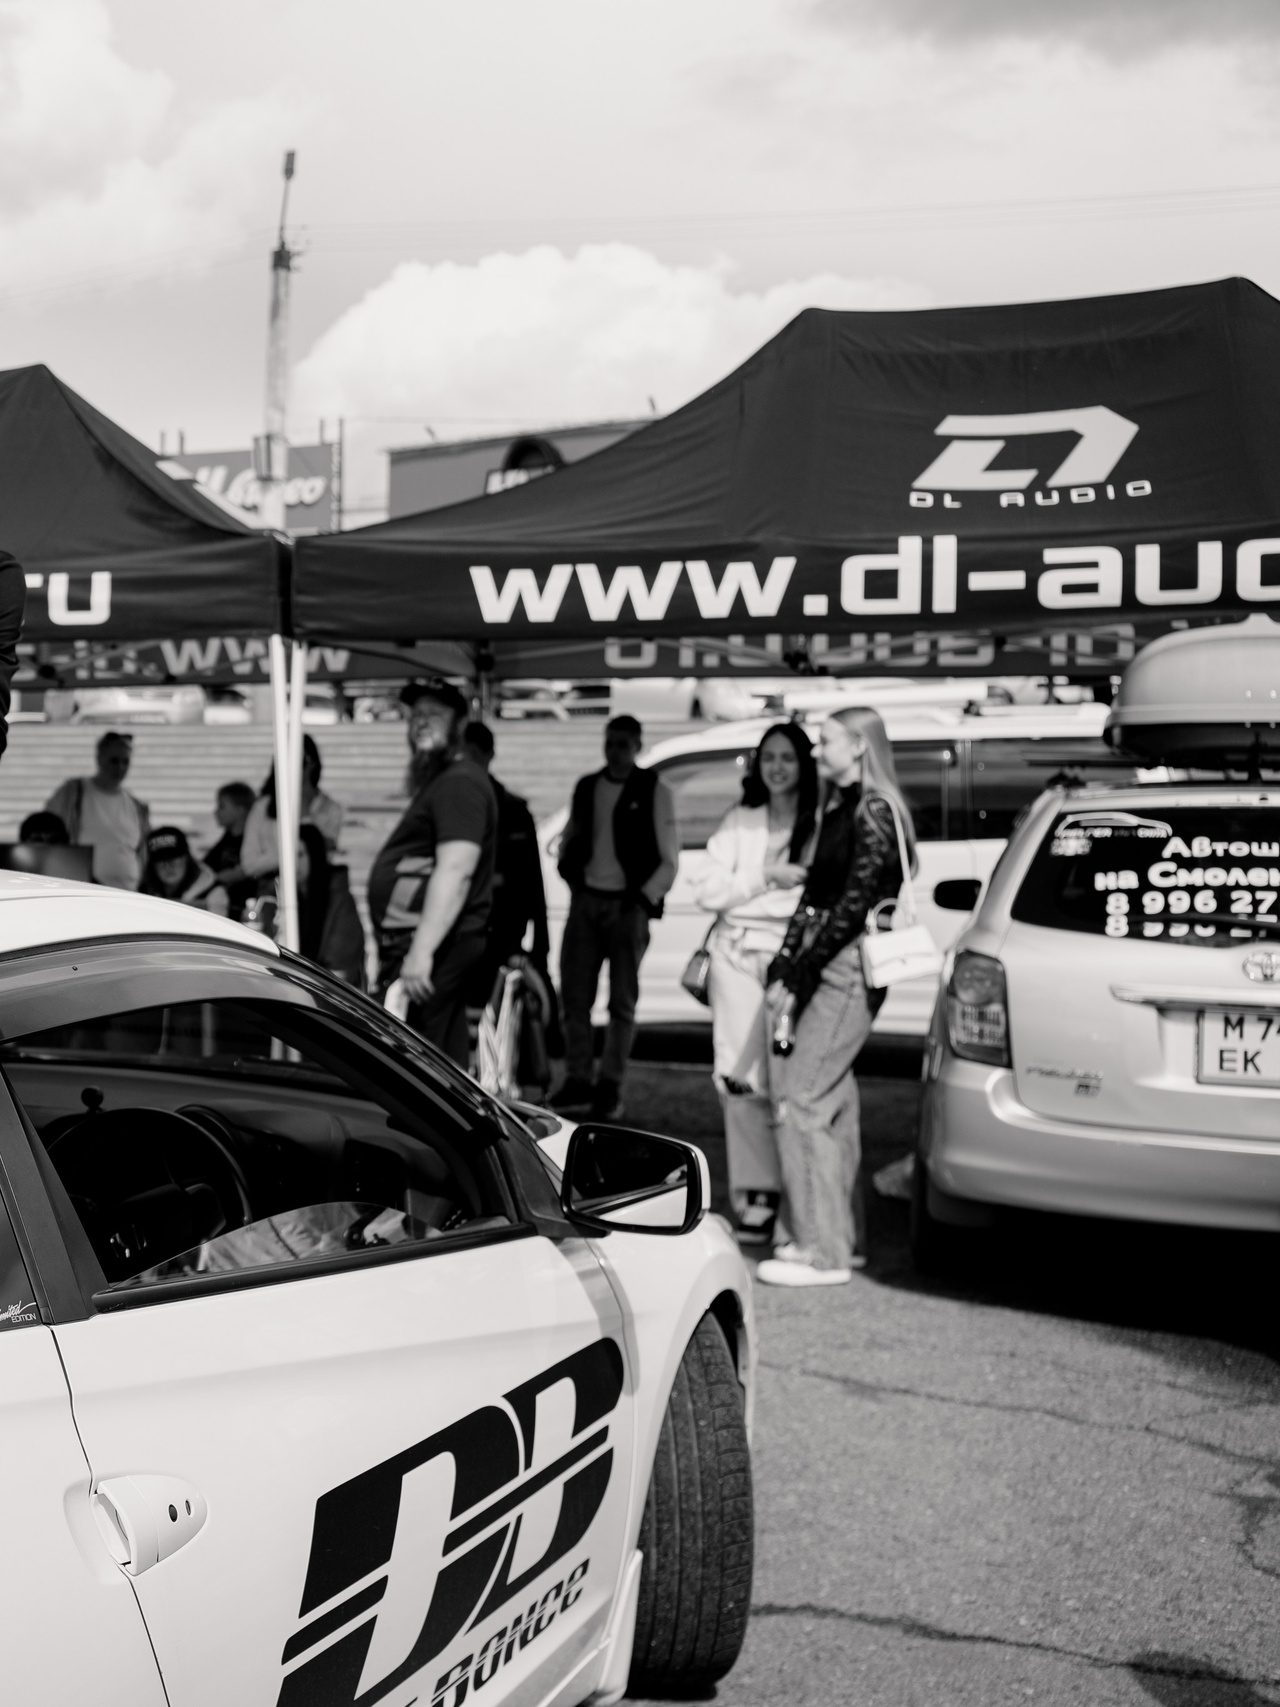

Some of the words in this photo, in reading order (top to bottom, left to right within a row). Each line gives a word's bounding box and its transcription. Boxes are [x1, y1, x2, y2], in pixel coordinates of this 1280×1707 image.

[909, 491, 962, 509] DL
[999, 480, 1152, 508] AUDIO
[1094, 869, 1139, 890] на
[1105, 892, 1130, 915] 8
[1142, 889, 1217, 914] 996
[1230, 889, 1277, 914] 27
[11, 1313, 37, 1323] EDITION
